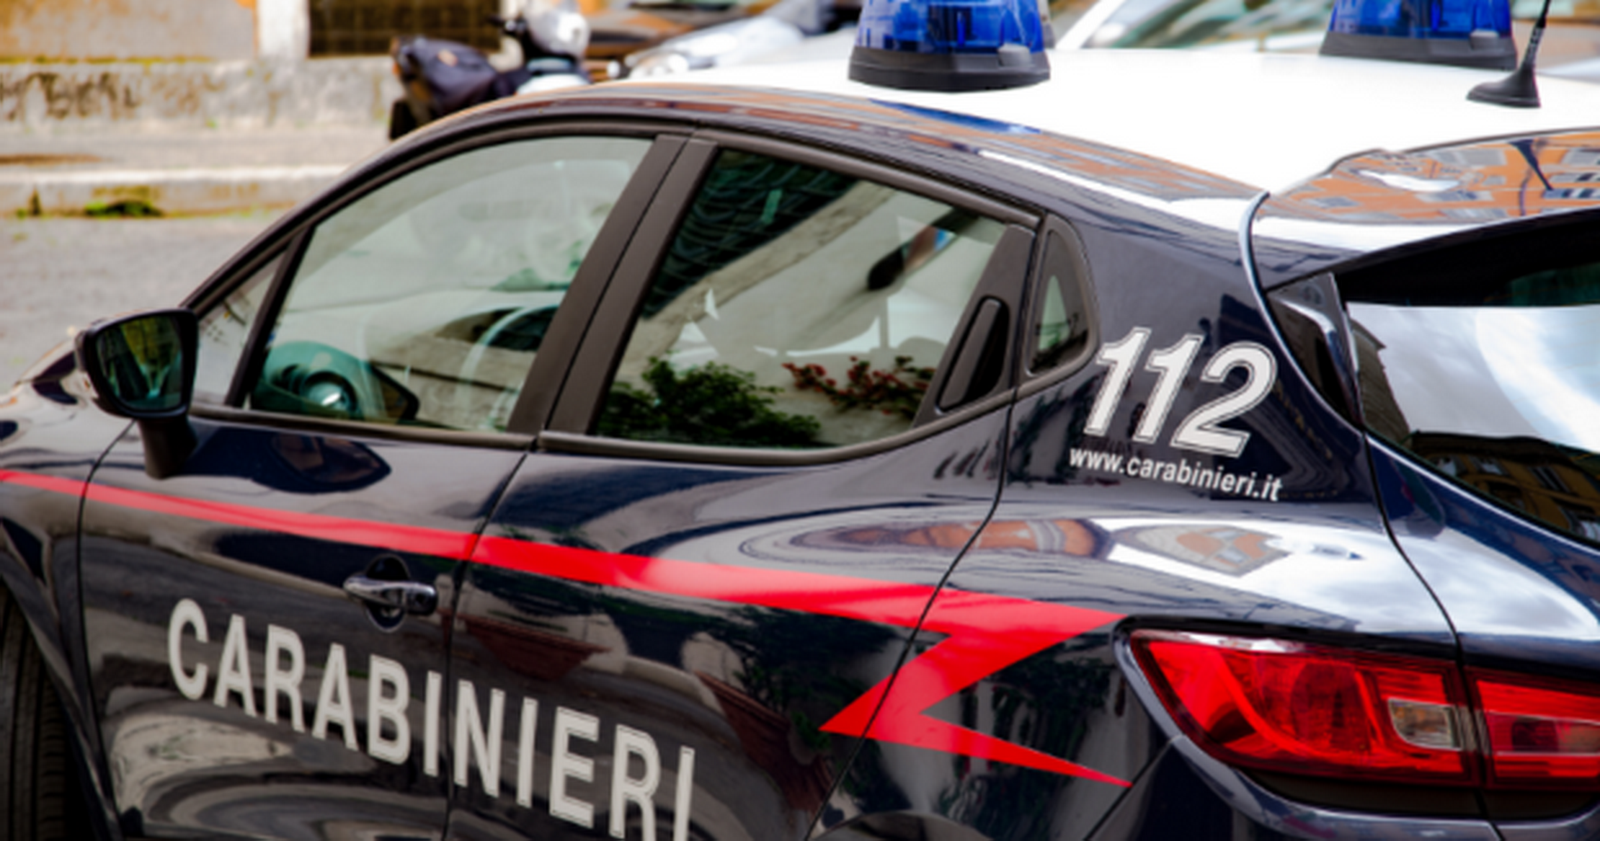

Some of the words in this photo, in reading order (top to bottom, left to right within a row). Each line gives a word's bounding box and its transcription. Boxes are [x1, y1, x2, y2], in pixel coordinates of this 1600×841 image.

[1083, 326, 1277, 458] 112
[1069, 447, 1283, 501] www.carabinieri.it
[168, 598, 695, 841] CARABINIERI
